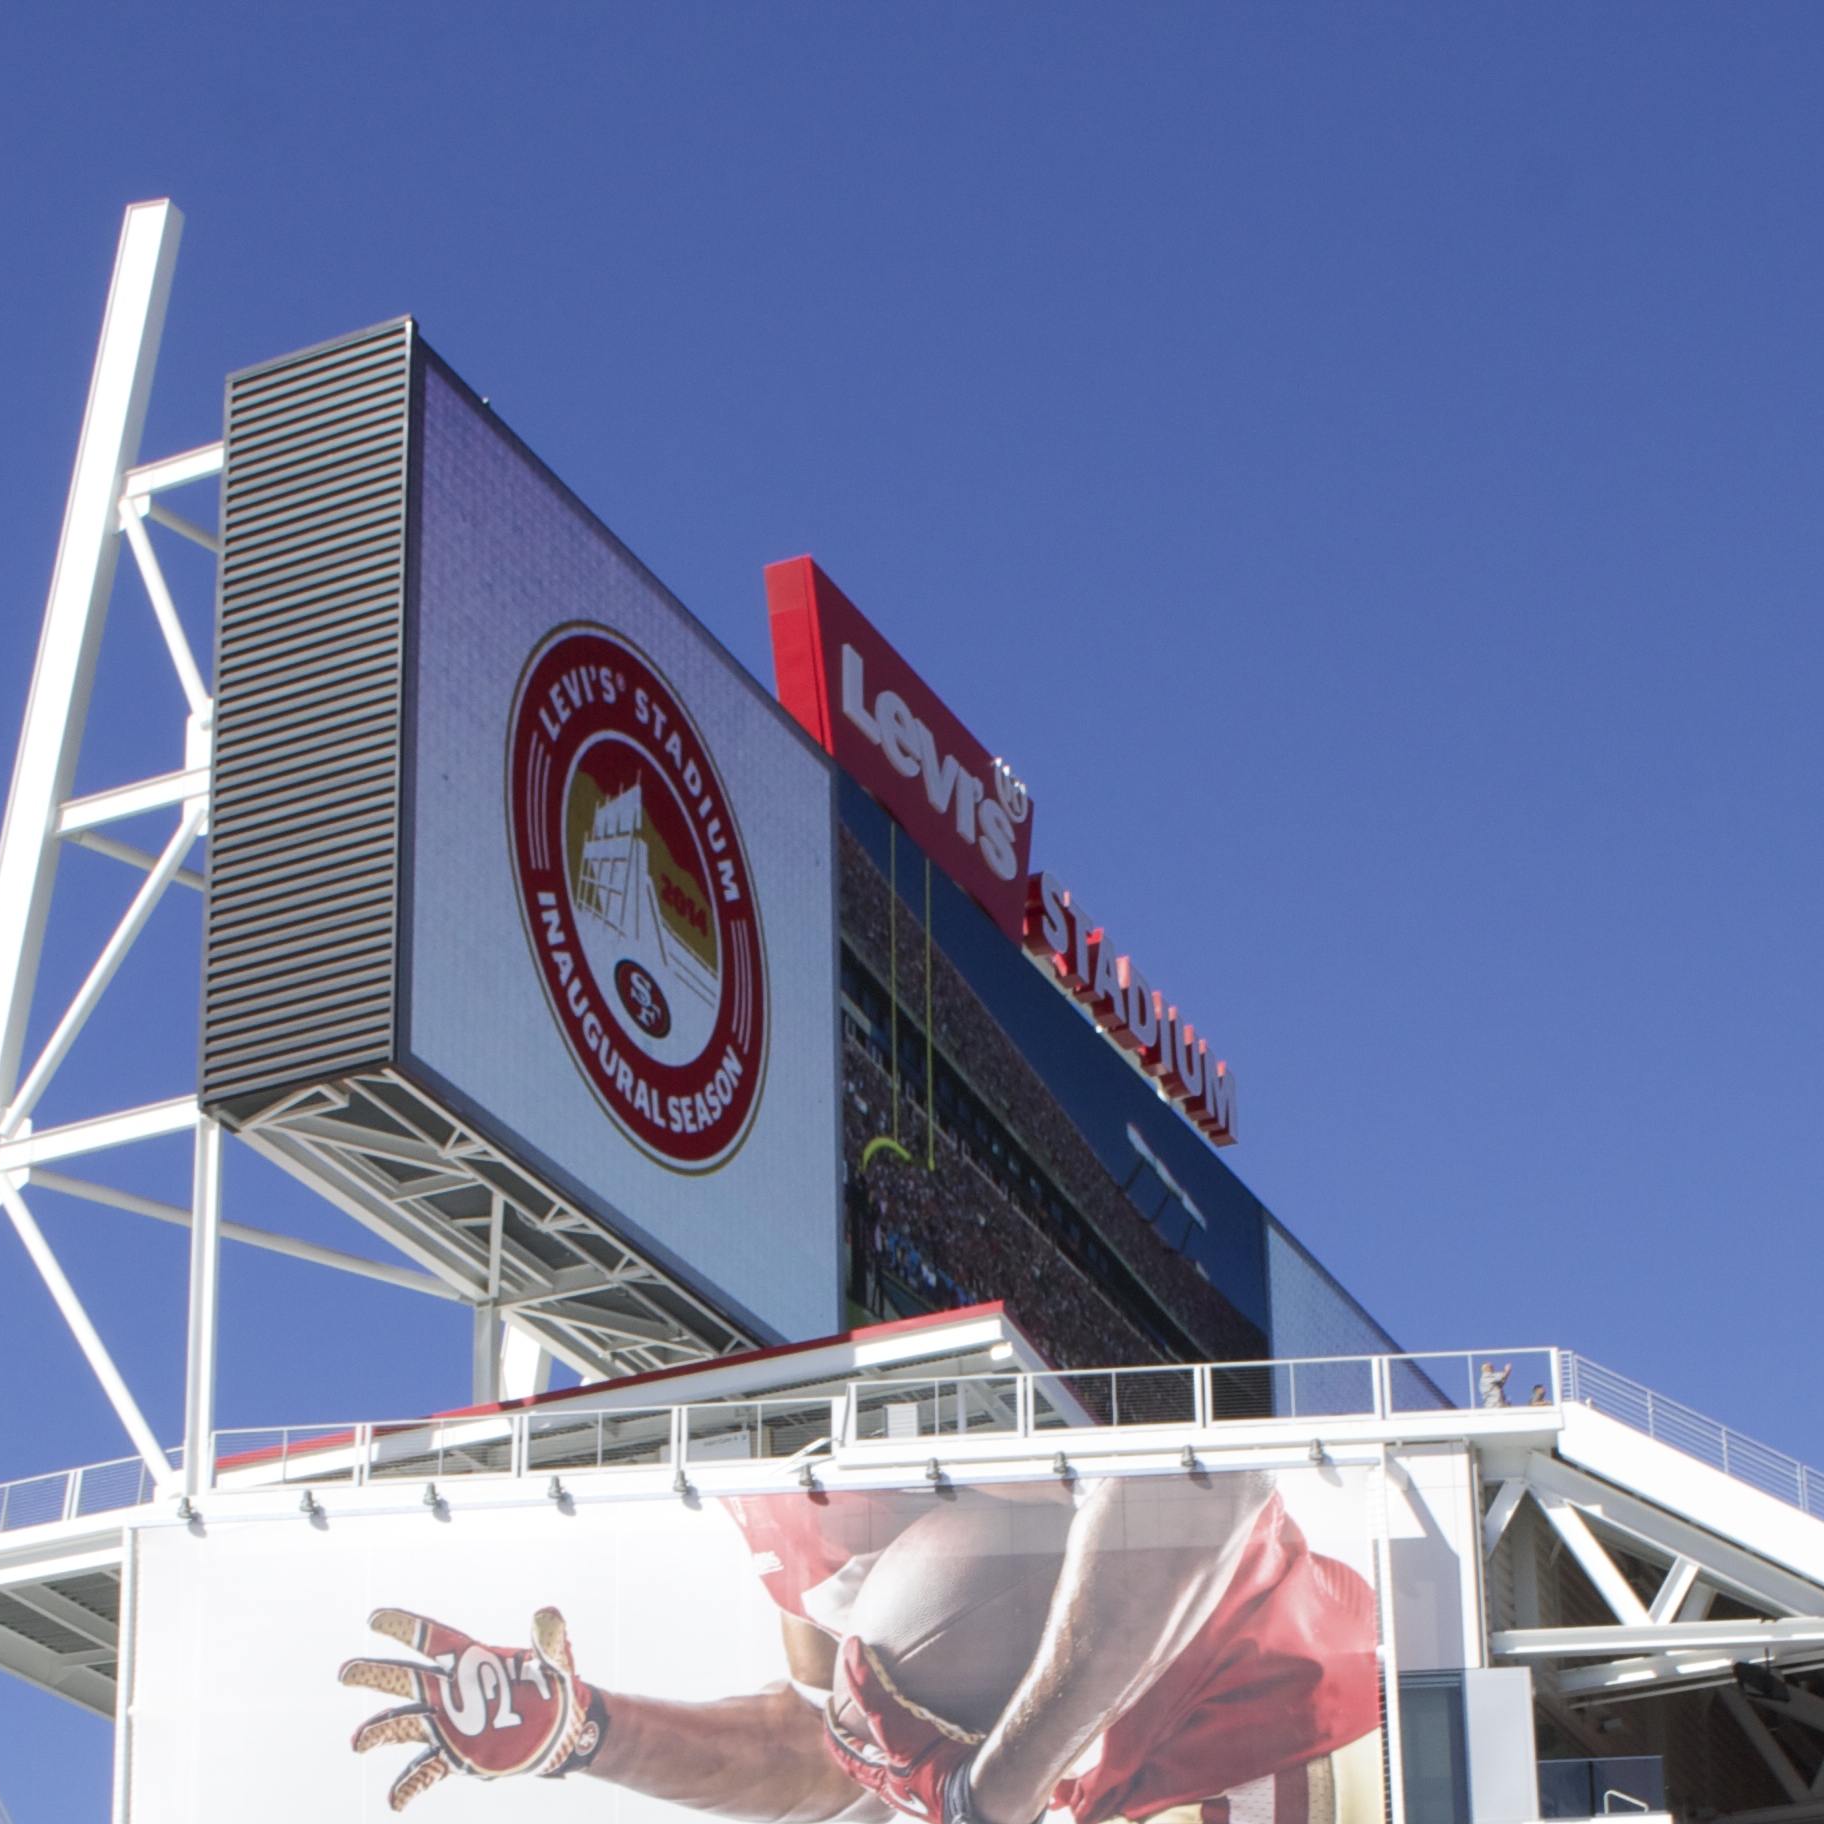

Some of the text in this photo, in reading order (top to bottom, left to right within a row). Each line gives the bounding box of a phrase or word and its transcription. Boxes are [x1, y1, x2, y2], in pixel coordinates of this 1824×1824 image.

[633, 687, 741, 903] STADIUM
[536, 890, 744, 1135] INAUGURAL SEASON
[1032, 869, 1238, 1148] STADIUM
